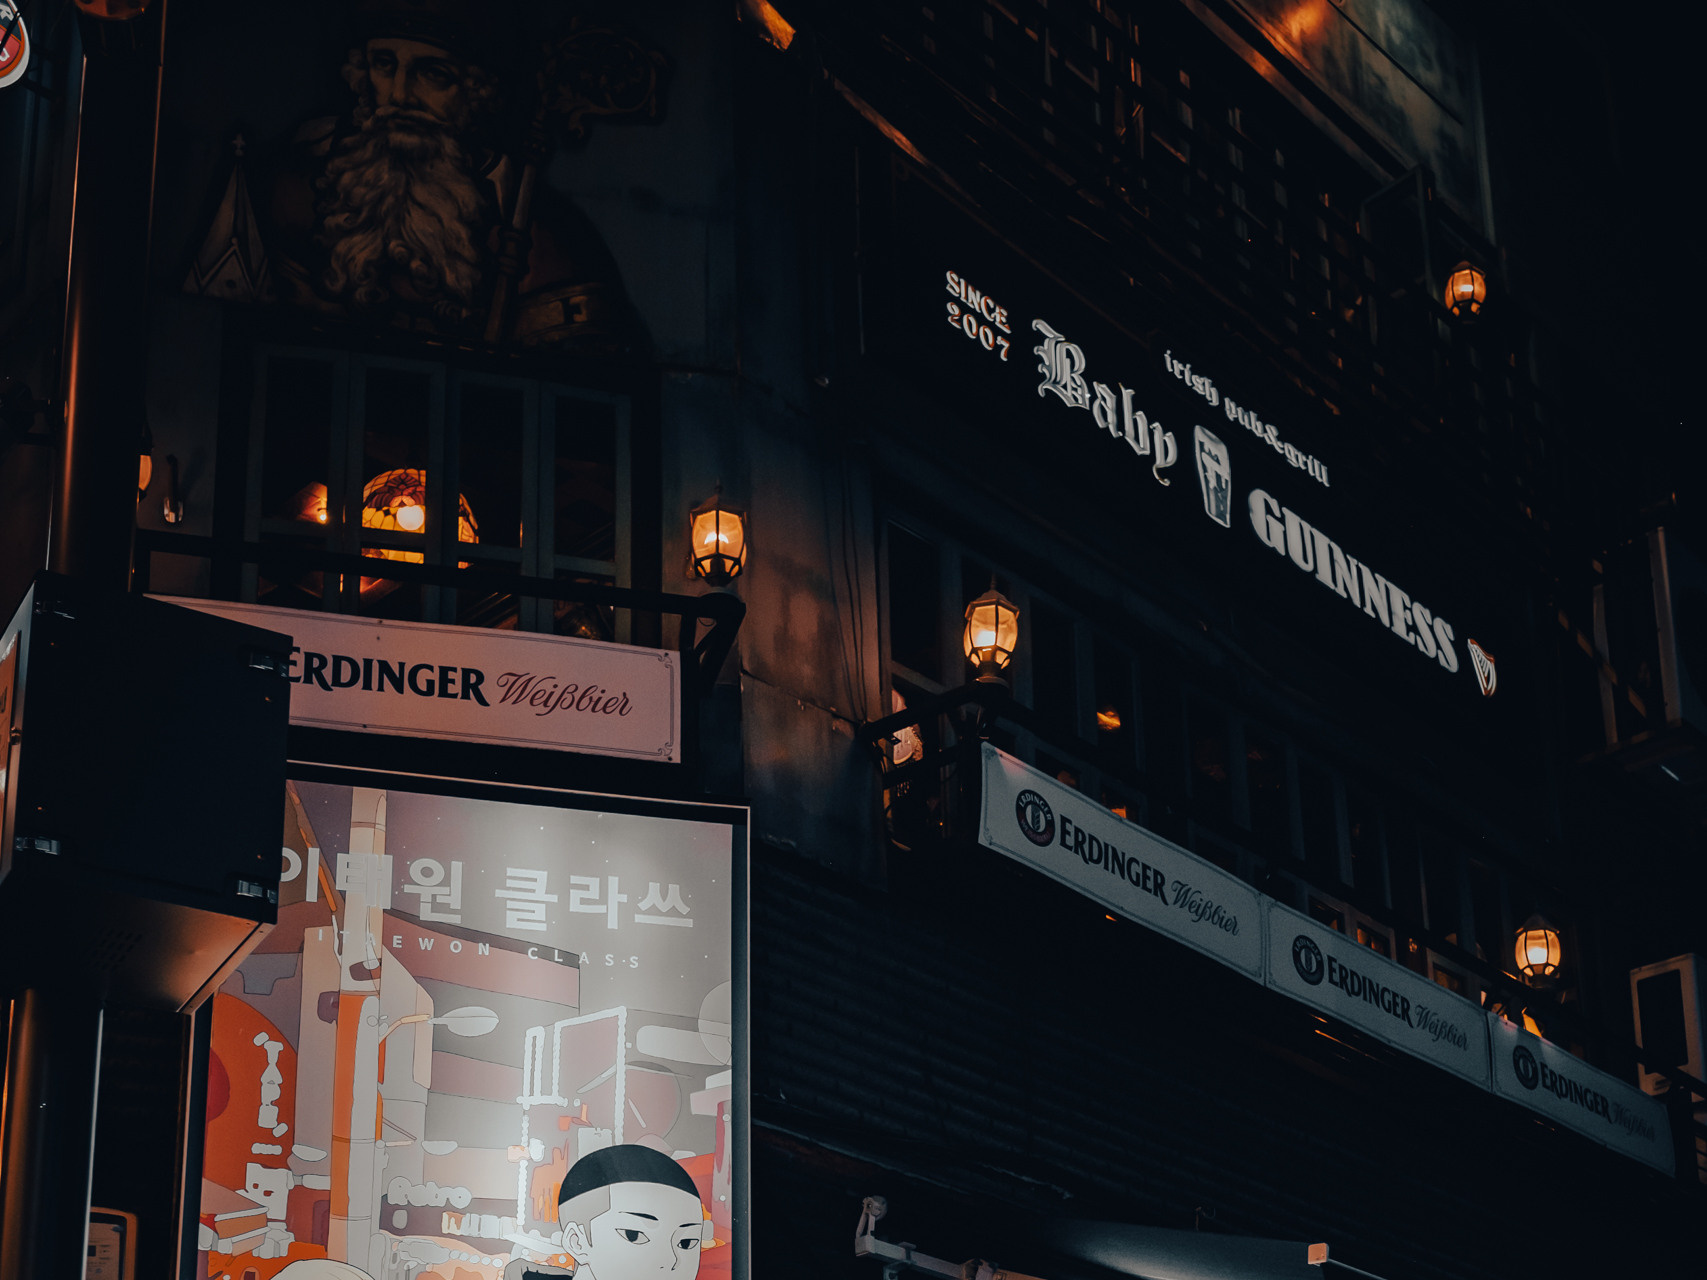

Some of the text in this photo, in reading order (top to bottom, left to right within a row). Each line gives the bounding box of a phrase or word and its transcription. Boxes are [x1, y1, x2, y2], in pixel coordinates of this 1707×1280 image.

[946, 269, 1012, 335] SINCE
[946, 301, 1011, 361] 2007
[1031, 317, 1178, 487] Baby
[1163, 349, 1219, 407] irish
[1247, 487, 1459, 674] GUINNESS
[496, 671, 633, 717] Weißbier
[494, 866, 694, 932] 클라쓰
[1059, 813, 1240, 937] ERDINGER Weißbier
[318, 928, 640, 969] ITAEWON CLASS
[1326, 954, 1414, 1029] ERDINGER
[1539, 1061, 1613, 1125] ERDINGER
